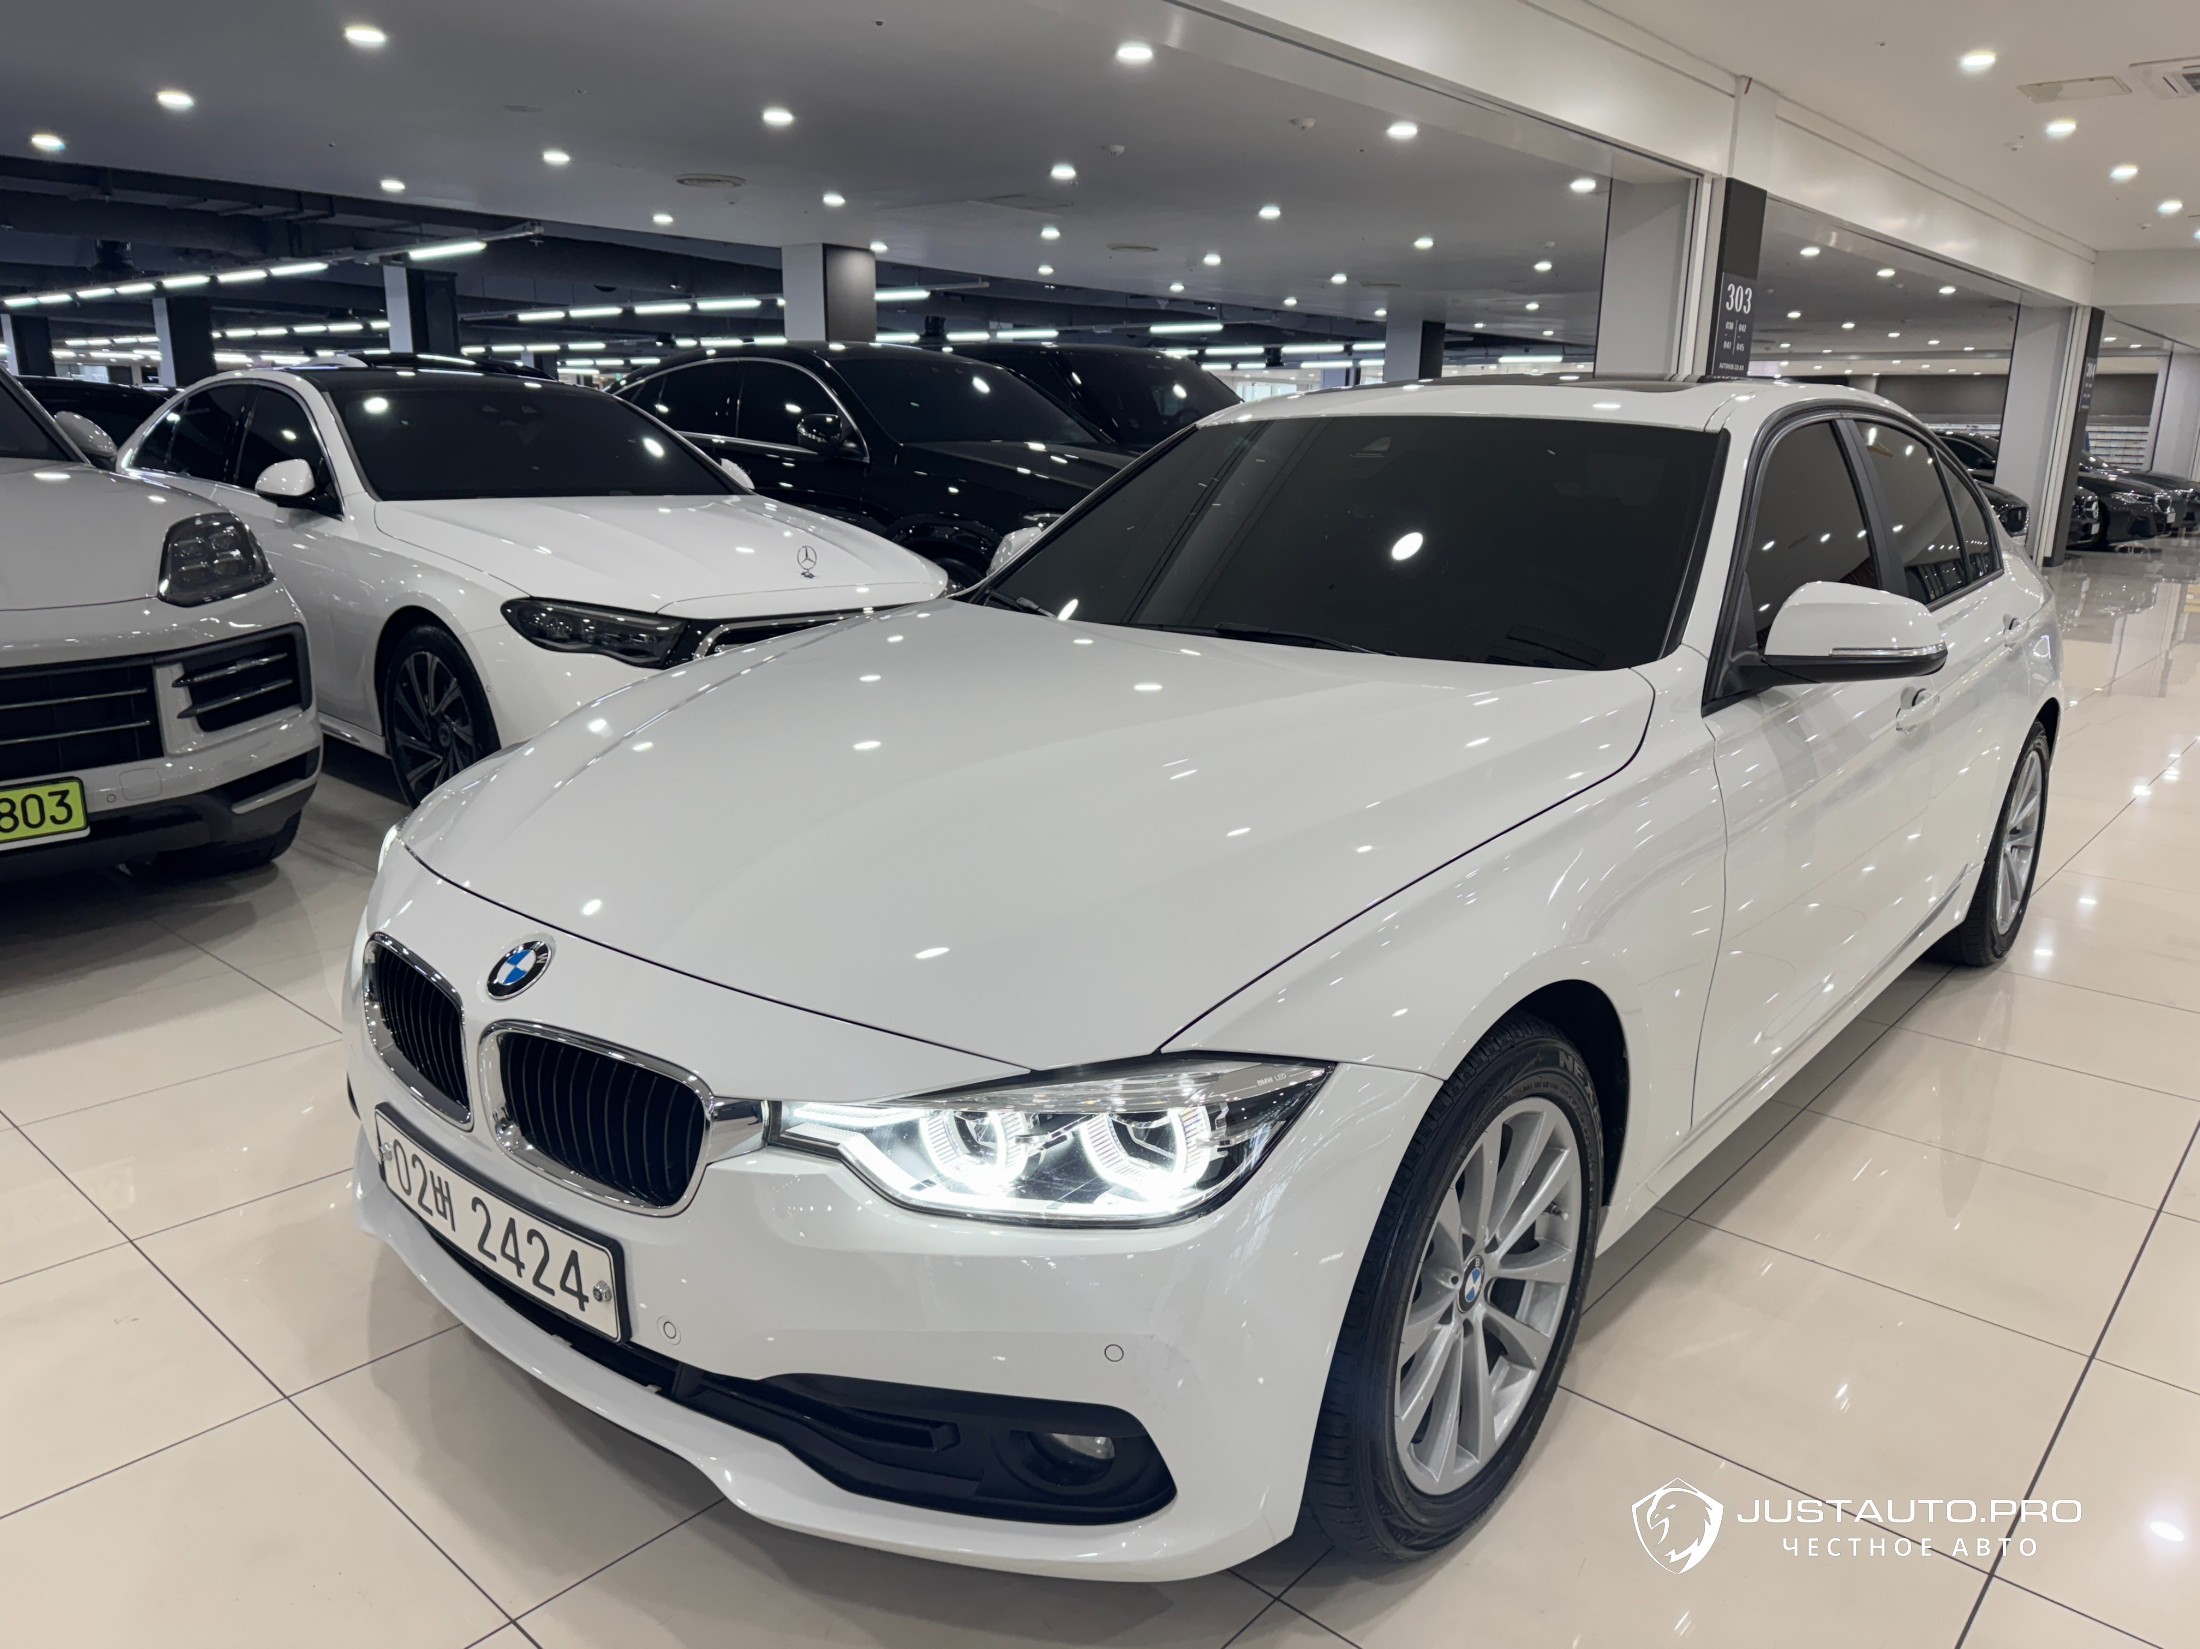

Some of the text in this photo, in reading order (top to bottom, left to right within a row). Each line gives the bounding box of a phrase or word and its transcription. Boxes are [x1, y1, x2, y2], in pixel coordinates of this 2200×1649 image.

[1726, 283, 1752, 314] 303
[0, 789, 73, 833] 803
[471, 1197, 589, 1311] 2424
